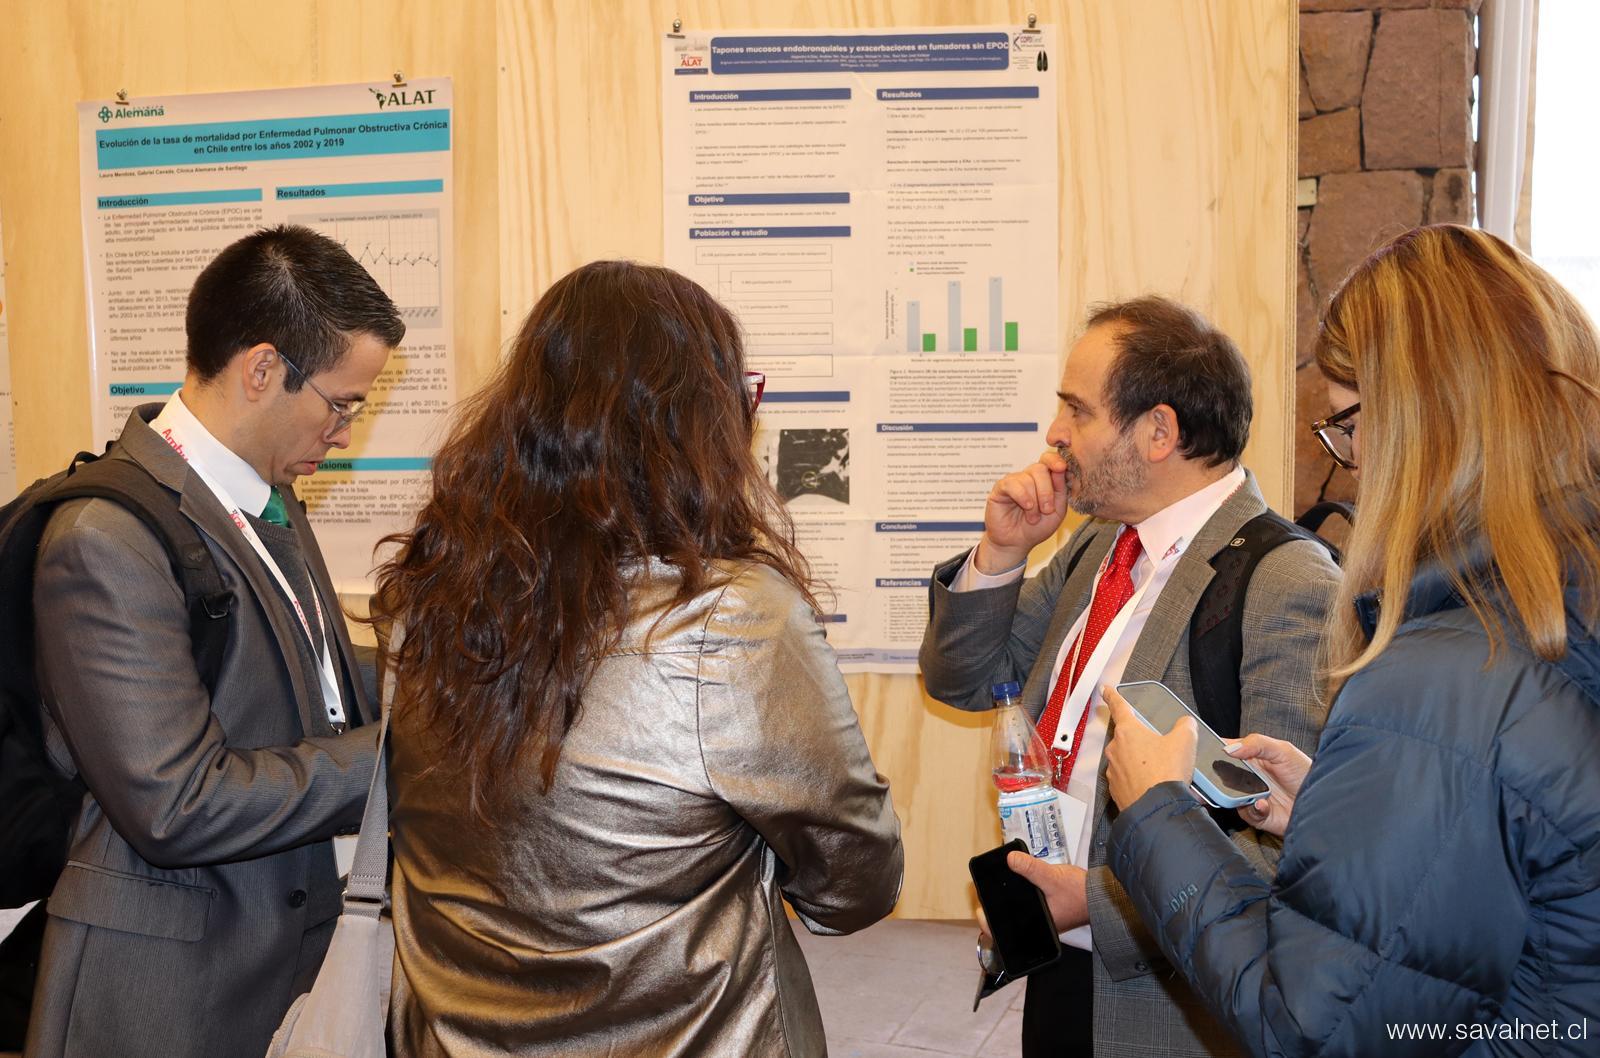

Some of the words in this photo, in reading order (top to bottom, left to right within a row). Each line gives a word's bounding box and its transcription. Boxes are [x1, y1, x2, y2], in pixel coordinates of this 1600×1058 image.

[712, 46, 744, 56] Tapones
[784, 45, 846, 54] endobronquiales
[857, 45, 916, 53] exacerbaciones
[682, 58, 702, 66] ALAT
[388, 90, 436, 106] ALAT
[694, 92, 738, 100] Introducción
[115, 108, 164, 119] Alemana
[100, 138, 139, 148] Evolución
[141, 137, 151, 145] de
[154, 136, 160, 145] la
[163, 135, 180, 144] tasa
[183, 134, 193, 143] de
[196, 132, 240, 142] mortalidad
[243, 132, 256, 141] por
[259, 128, 311, 138] Enfermedad
[314, 125, 356, 135] Pulmonar
[359, 122, 410, 132] Obstructiva
[414, 120, 448, 129] Crónica
[207, 144, 228, 153] Chile
[231, 143, 252, 152] entre
[255, 142, 267, 150] los
[270, 141, 291, 149] años
[294, 139, 313, 148] 2002
[316, 141, 320, 149] y
[325, 138, 344, 146] 2019
[278, 188, 326, 198] Resultados
[99, 198, 149, 208] Introducción
[694, 195, 724, 204] Objetivo
[695, 230, 730, 238] Población
[111, 386, 144, 396] Objetivo
[880, 579, 922, 587] Referencias
